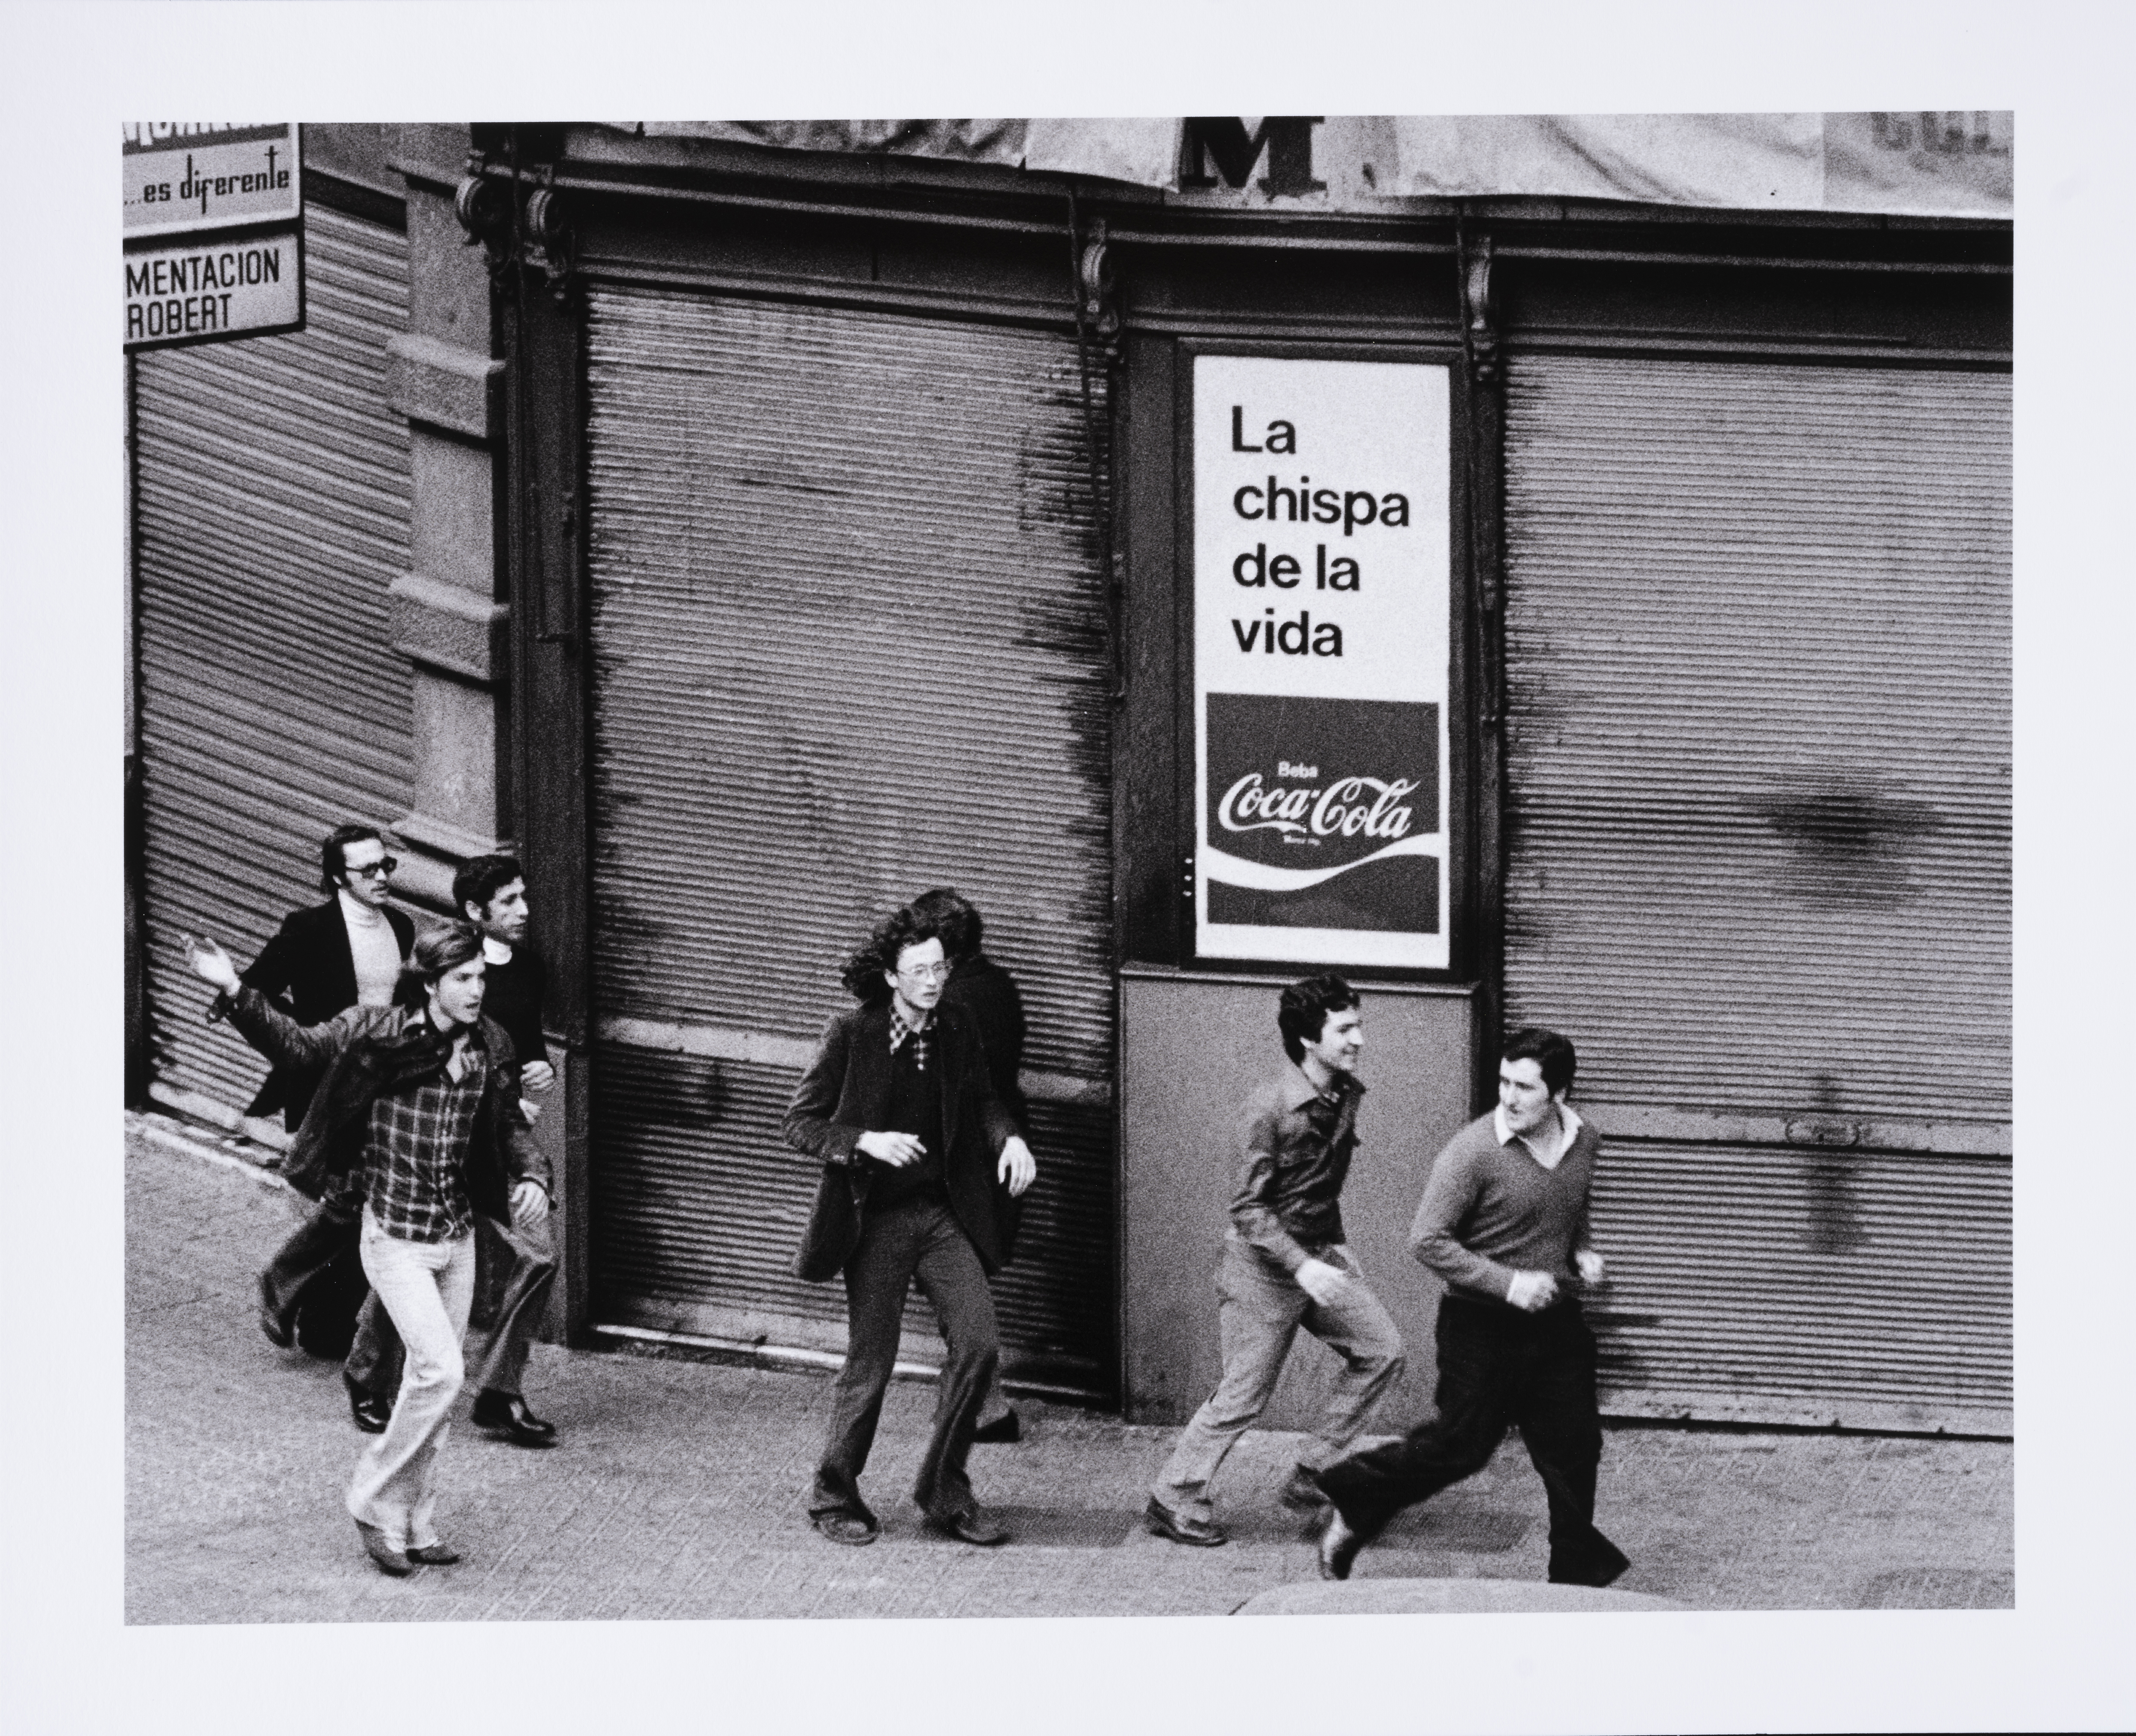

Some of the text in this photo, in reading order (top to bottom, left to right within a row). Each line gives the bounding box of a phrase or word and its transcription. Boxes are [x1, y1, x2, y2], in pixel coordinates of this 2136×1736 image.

[180, 145, 290, 214] diferente
[126, 249, 279, 297] MENTACION
[128, 294, 232, 338] ROBERT
[1232, 405, 1296, 454] La
[1233, 475, 1410, 536] chispa
[1232, 543, 1360, 591] de la
[1231, 608, 1343, 657] vida
